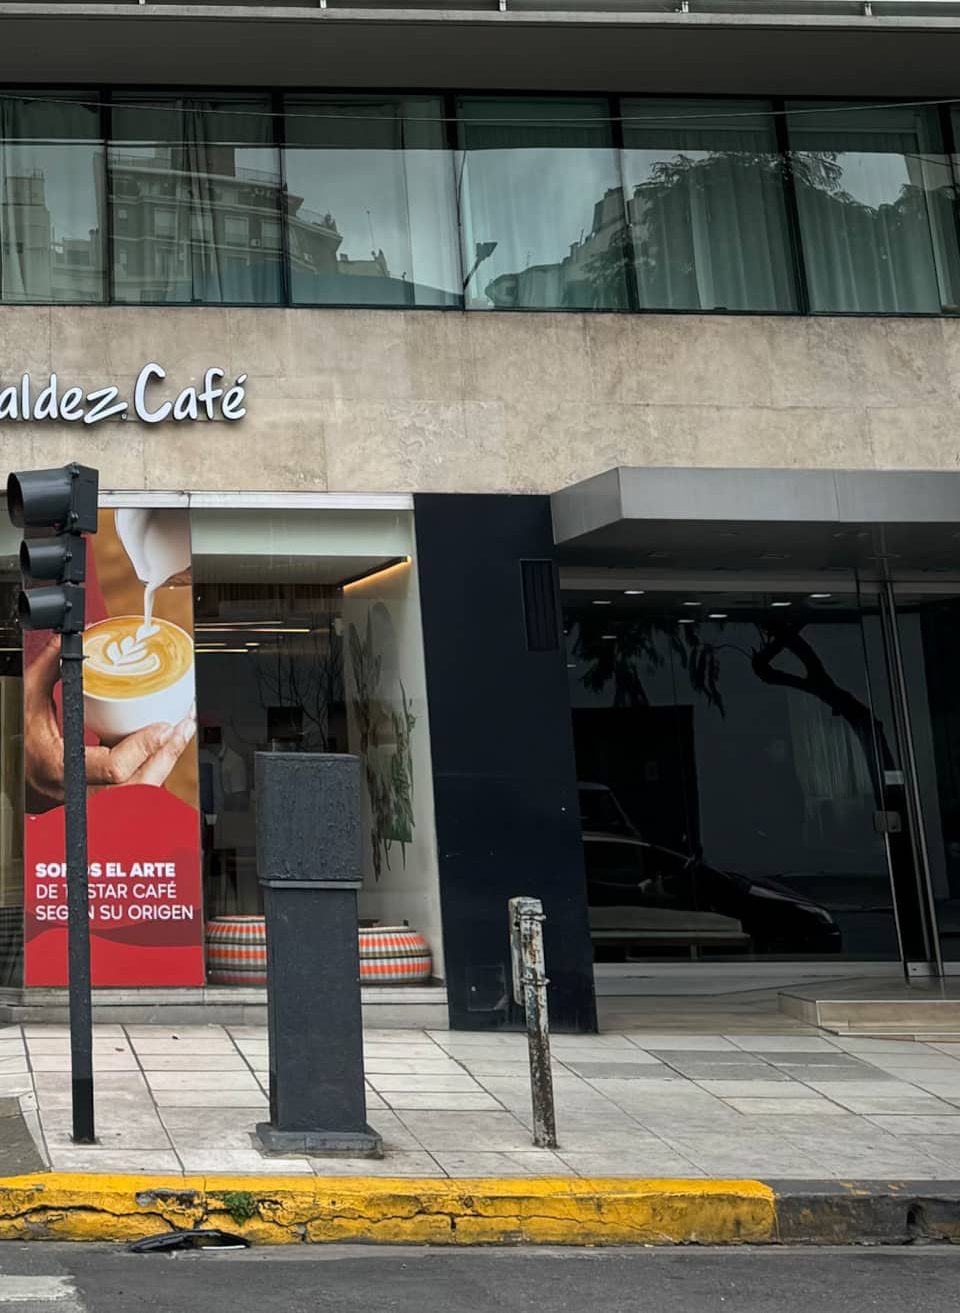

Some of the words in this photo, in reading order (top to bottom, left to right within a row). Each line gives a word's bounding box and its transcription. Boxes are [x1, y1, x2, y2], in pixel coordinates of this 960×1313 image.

[134, 362, 247, 423] Café
[35, 862, 102, 878] SOS
[105, 862, 127, 878] EL
[129, 862, 176, 878] ARTE
[36, 883, 58, 899] DE
[62, 883, 128, 899] STAR
[132, 880, 177, 899] CAFÉ
[35, 905, 95, 920] SEGN
[100, 904, 123, 920] SU
[127, 904, 193, 920] ORIGEN
